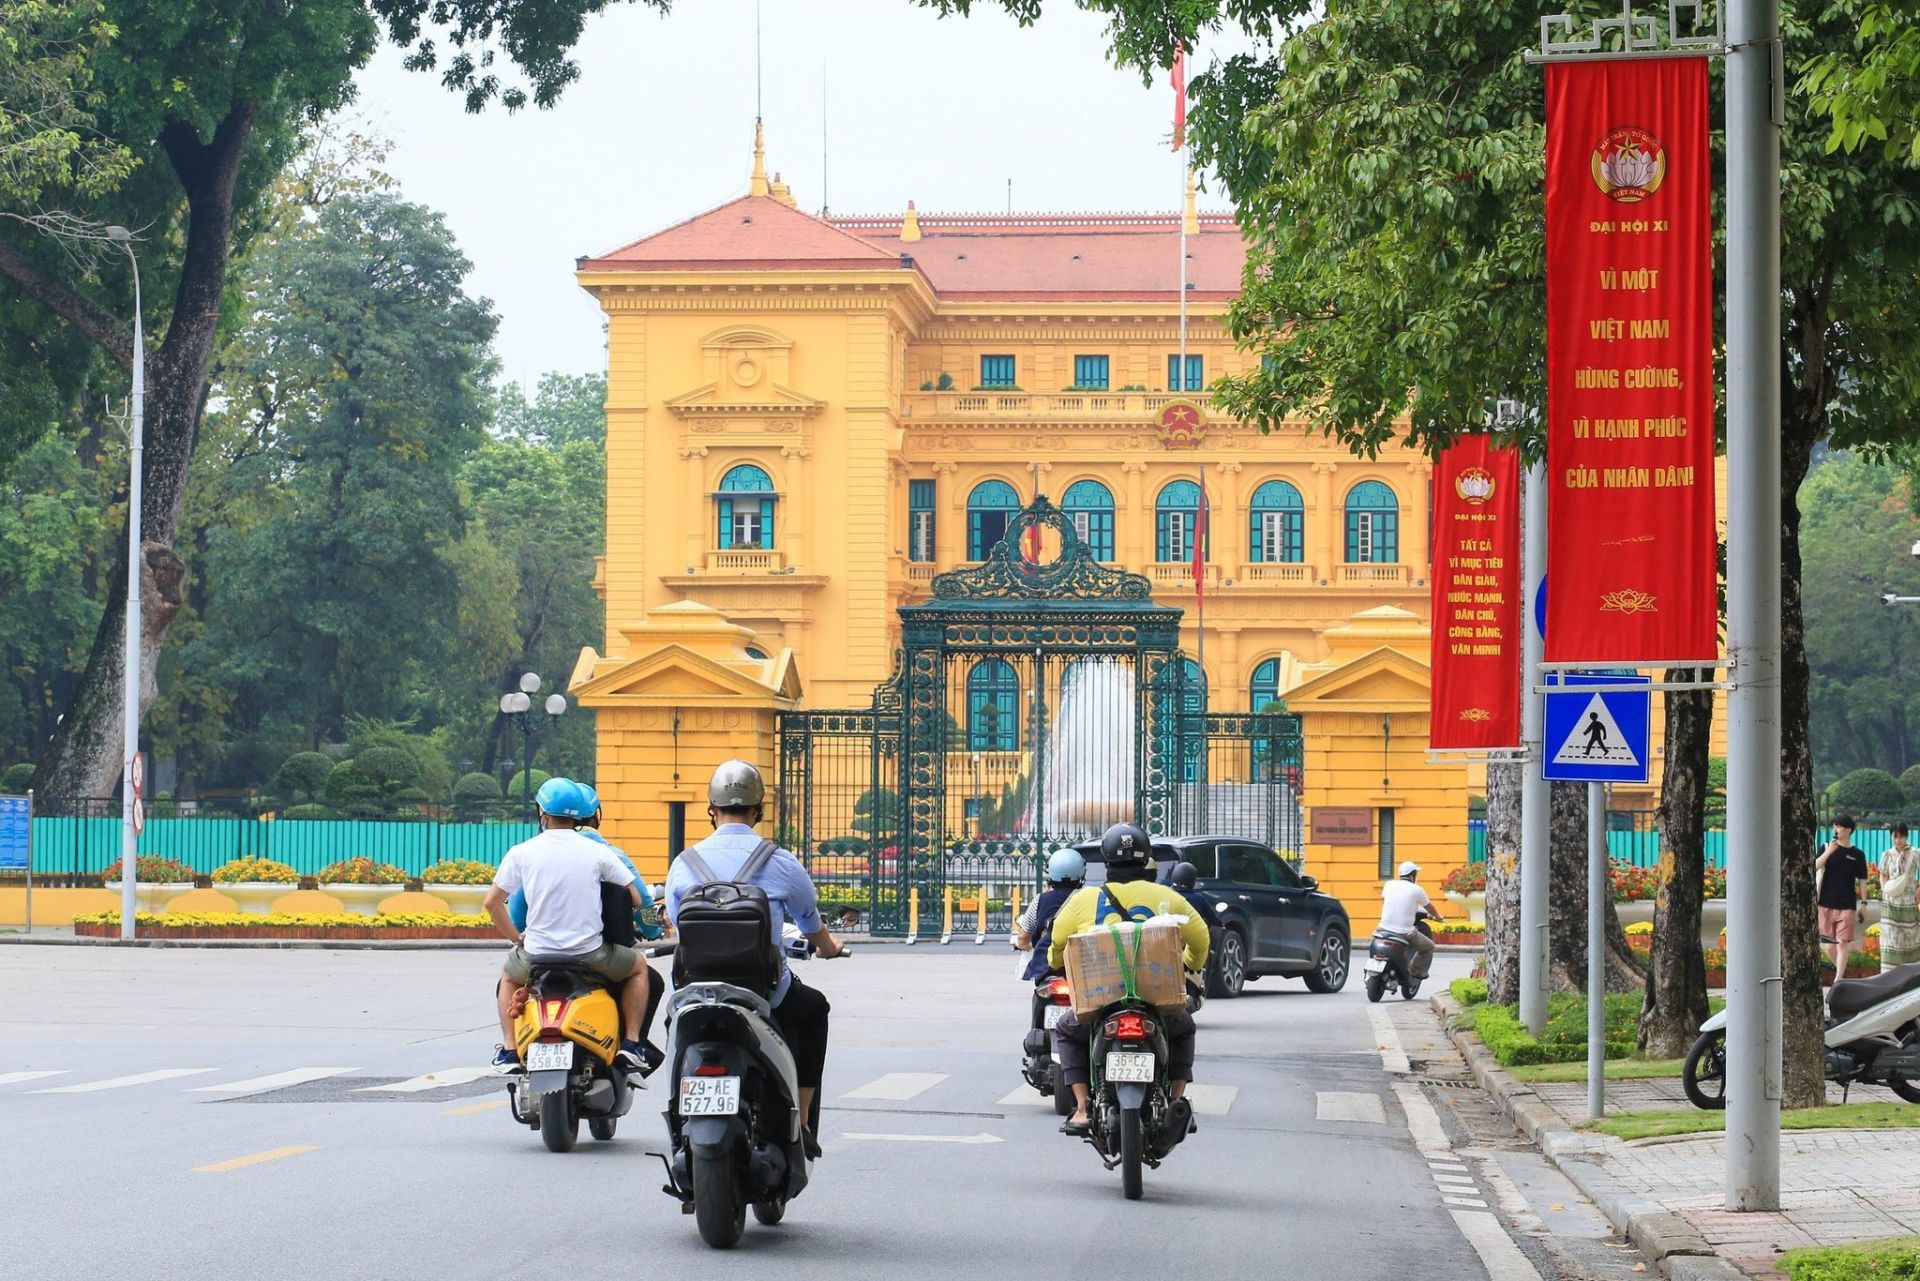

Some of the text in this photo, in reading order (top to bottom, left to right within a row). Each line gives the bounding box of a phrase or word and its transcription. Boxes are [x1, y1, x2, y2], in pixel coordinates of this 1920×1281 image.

[1589, 219, 1668, 235] ĐẠI HỘI XI
[1600, 267, 1658, 293] VÌ MỘT
[1590, 317, 1669, 343] VIỆT NAM
[1575, 364, 1684, 389] HÙNG CƯỜNG,
[1573, 414, 1687, 441] VÌ HẠNH PHÚC
[1566, 464, 1694, 488] CỦA NHÂN DÂN!
[1460, 538, 1492, 551] TẤT CẢ
[1449, 555, 1503, 570] VÌ MỤC TIÊU
[1454, 574, 1498, 587] DÂN GIÀU,
[1474, 592, 1505, 605] MẠNH,
[1455, 608, 1474, 620] DÂN
[1449, 624, 1503, 640] CÔNG BẰNG,
[1451, 642, 1470, 655] VĂN
[534, 1044, 565, 1057] 29-AC
[1114, 1056, 1147, 1067] 36-C2
[1109, 1068, 1150, 1080] 322.24
[690, 1080, 731, 1095] 29-AE
[684, 1097, 734, 1112] 527.96
